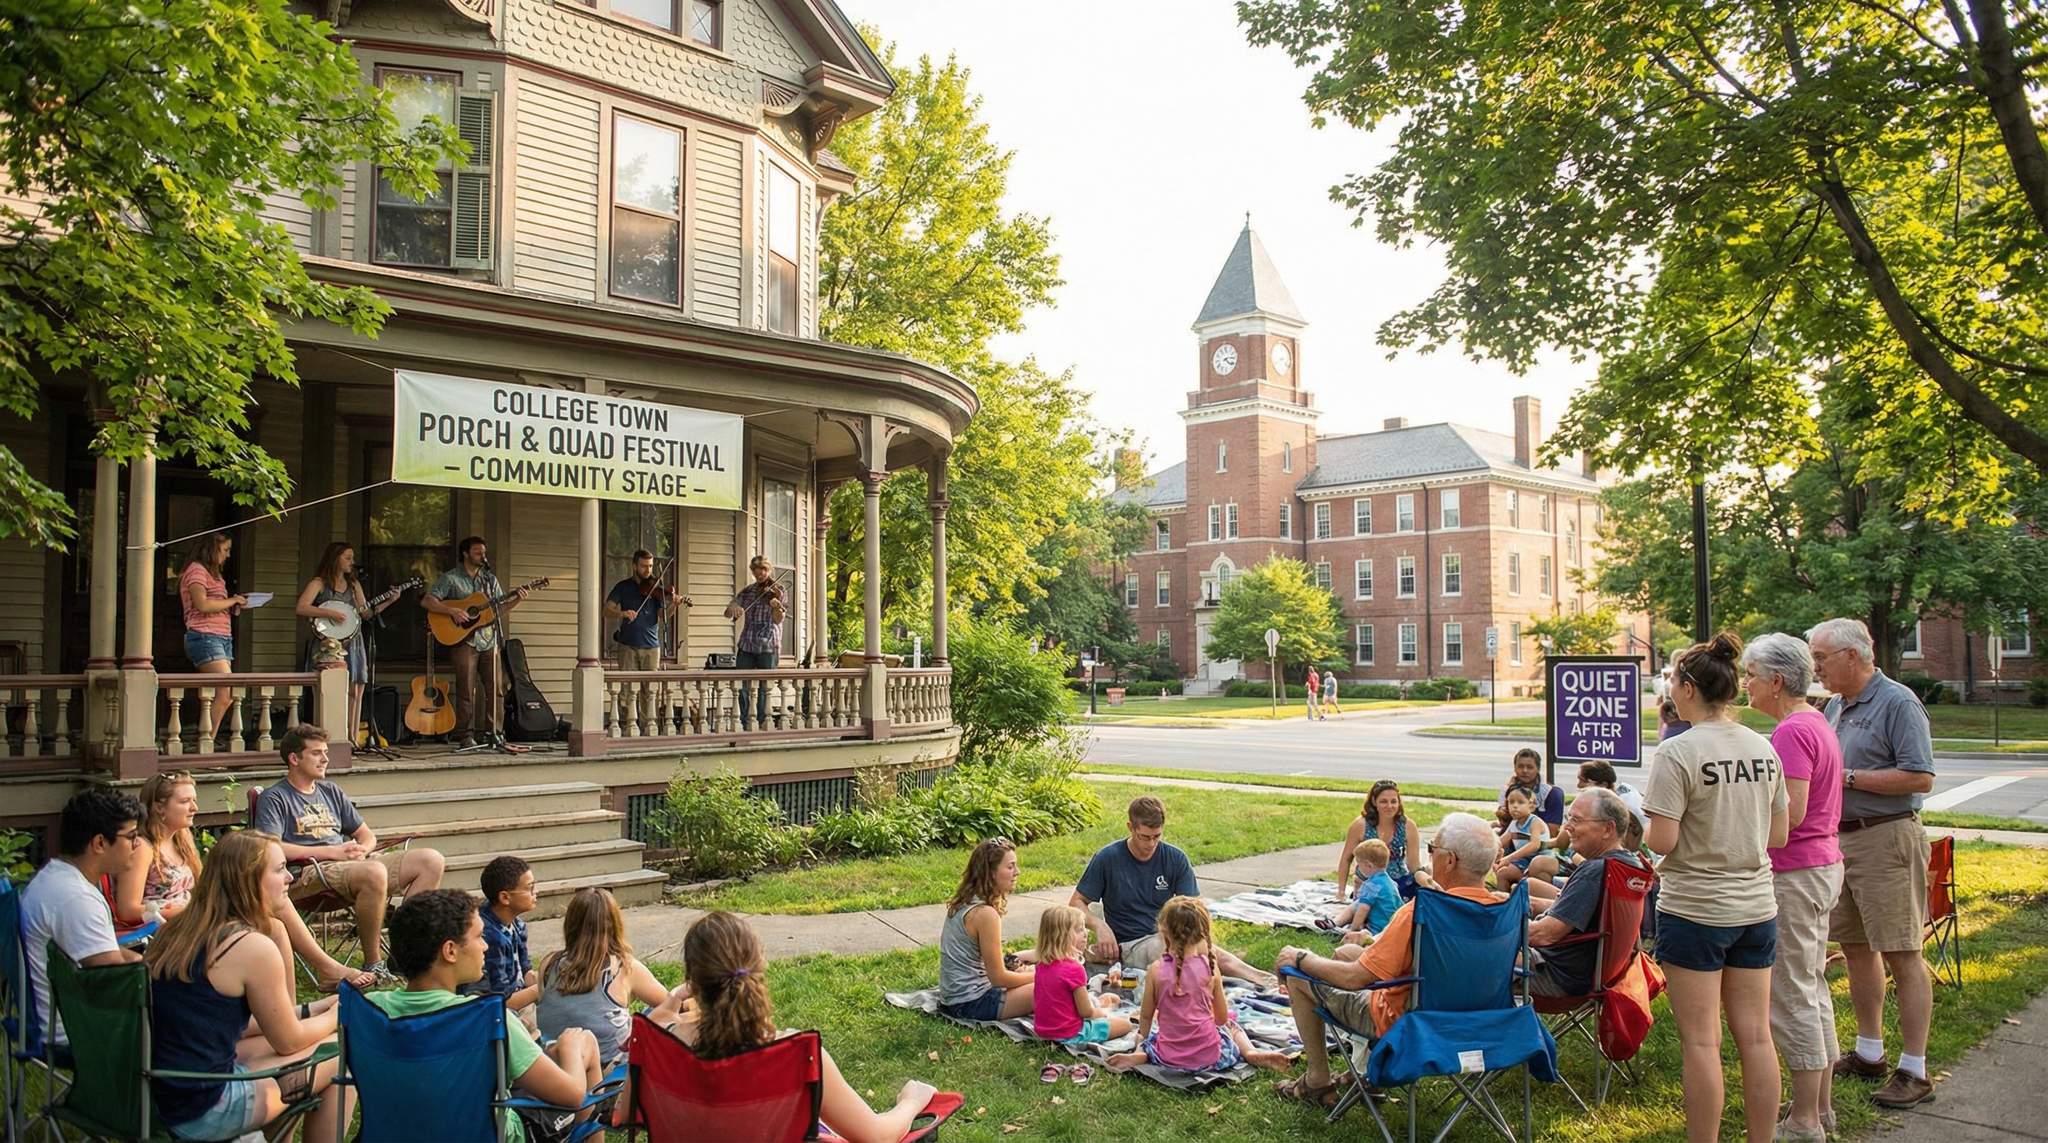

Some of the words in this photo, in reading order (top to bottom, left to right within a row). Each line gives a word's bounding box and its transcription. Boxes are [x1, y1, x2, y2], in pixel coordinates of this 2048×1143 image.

[493, 388, 599, 425] COLLEGE
[606, 402, 669, 433] TOWN
[419, 412, 511, 450] PORCH
[520, 425, 540, 453] &
[549, 426, 615, 461] QUAD
[623, 434, 725, 473] FESTIVAL
[470, 455, 615, 492] COMMUNITY
[622, 469, 688, 498] STAGE
[1561, 670, 1631, 693] QUIET
[1564, 696, 1629, 718] ZONE
[1571, 722, 1622, 738] AFTER
[1577, 739, 1588, 754] 6
[1592, 740, 1615, 756] PM
[1701, 758, 1776, 786] STAFF
